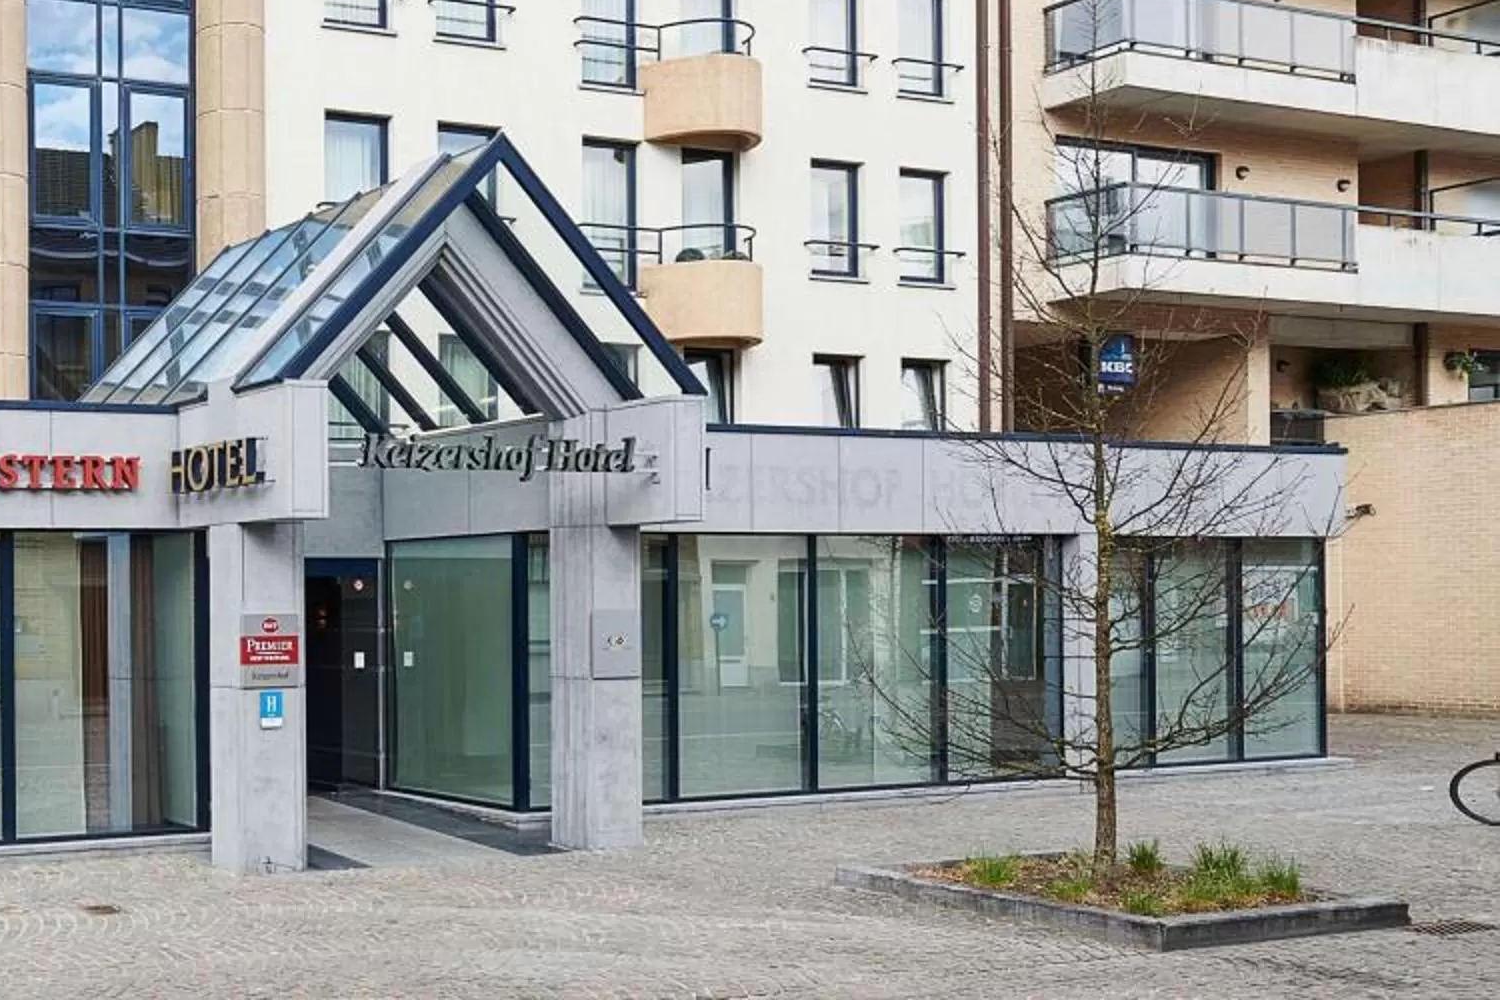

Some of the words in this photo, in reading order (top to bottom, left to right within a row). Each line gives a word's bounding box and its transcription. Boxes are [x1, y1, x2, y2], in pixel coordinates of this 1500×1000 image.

[168, 437, 262, 495] HOTEL
[361, 432, 544, 482] Keizershof
[547, 436, 636, 473] Hotel
